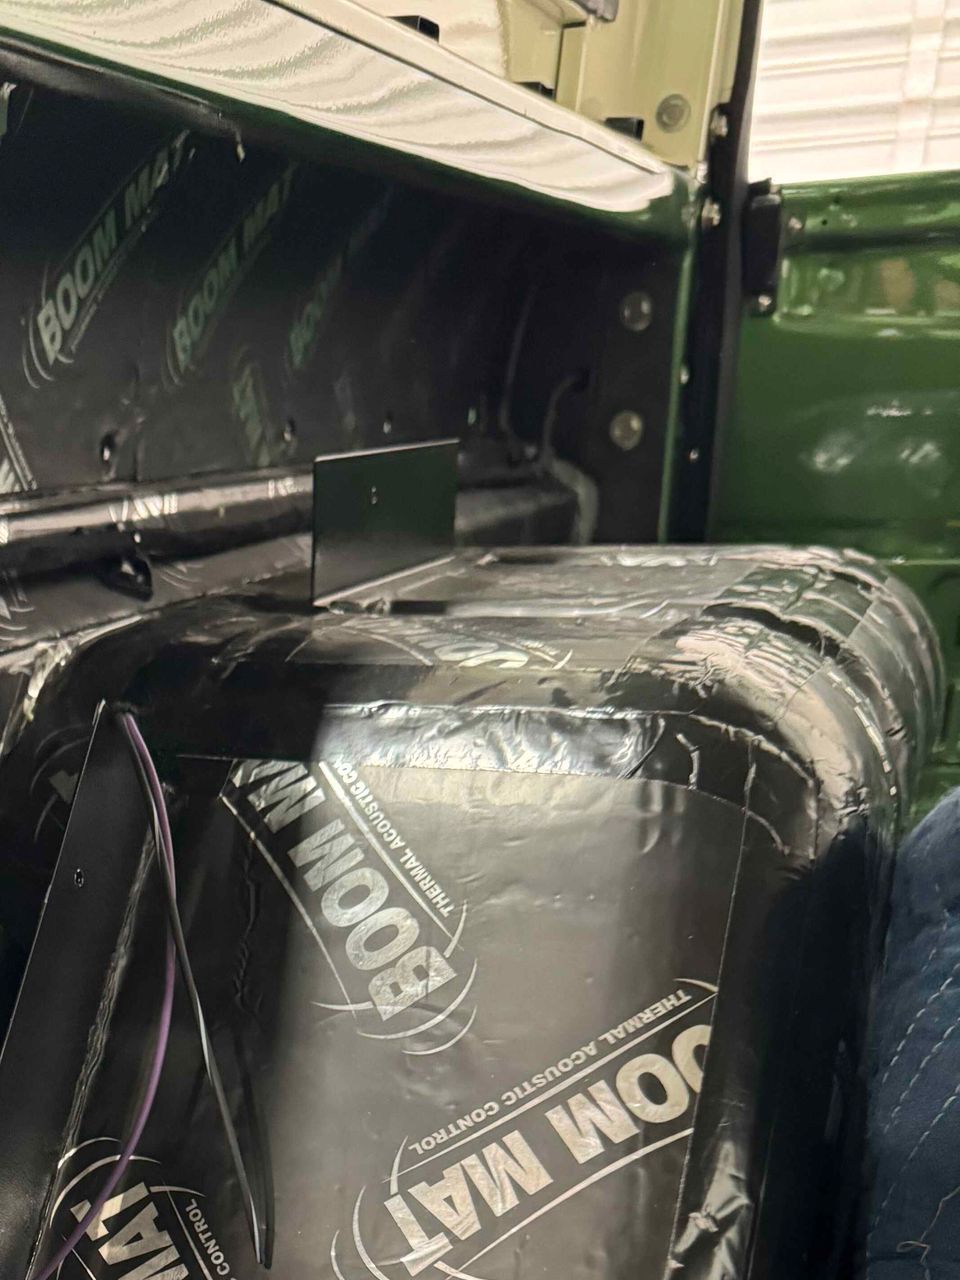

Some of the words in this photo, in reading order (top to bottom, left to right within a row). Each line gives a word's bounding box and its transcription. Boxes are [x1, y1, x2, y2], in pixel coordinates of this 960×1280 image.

[36, 207, 117, 366] BOOM
[173, 238, 238, 373] BOOM
[351, 782, 408, 851] ACOUSTIC
[288, 818, 458, 1022] BOOM
[399, 848, 456, 918] THERMAL
[599, 988, 693, 1045] THERMAL
[501, 1042, 599, 1106] ACOUSTIC
[407, 1101, 500, 1155] CONTROL
[184, 1198, 230, 1277] CONTROL
[383, 1129, 554, 1277] MAT
